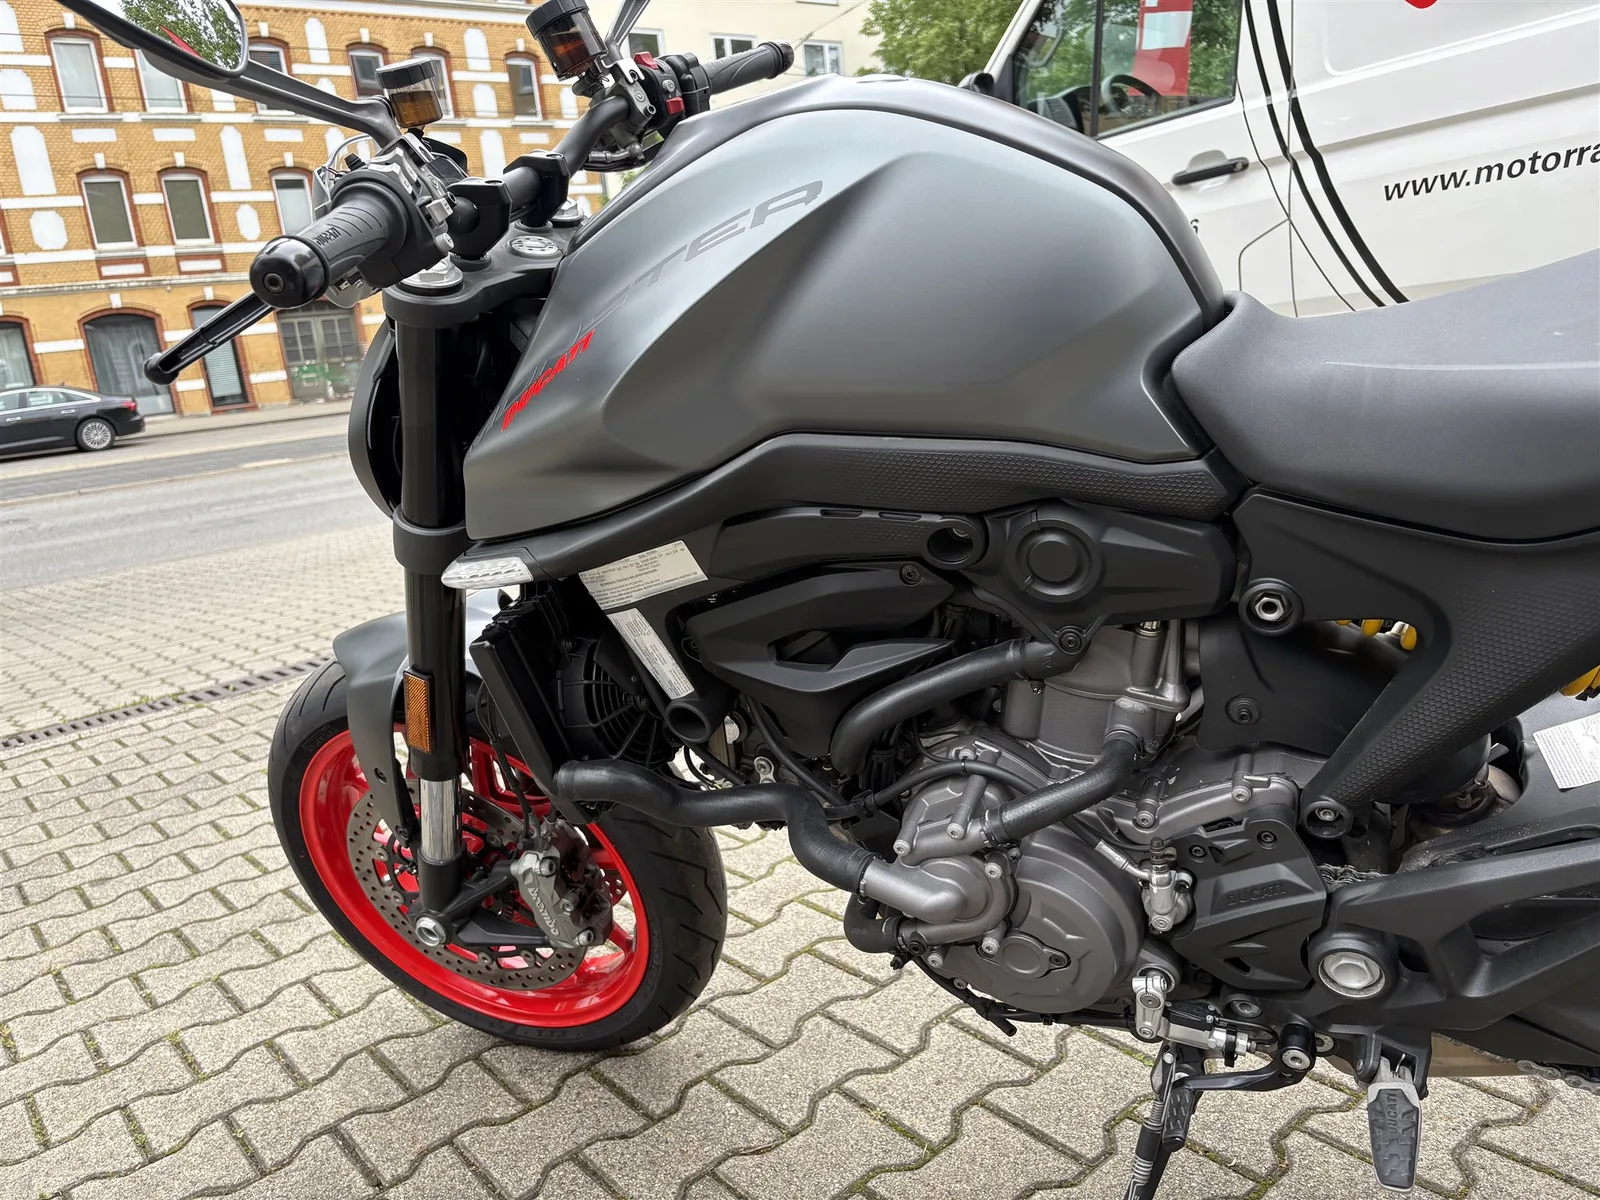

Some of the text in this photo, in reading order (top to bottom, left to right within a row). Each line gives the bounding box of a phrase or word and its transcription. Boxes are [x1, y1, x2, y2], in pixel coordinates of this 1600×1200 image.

[501, 328, 595, 432] DUCATI
[527, 887, 560, 936] brembo
[1226, 884, 1287, 906] DUCATI
[1386, 1091, 1399, 1135] DUCATI
